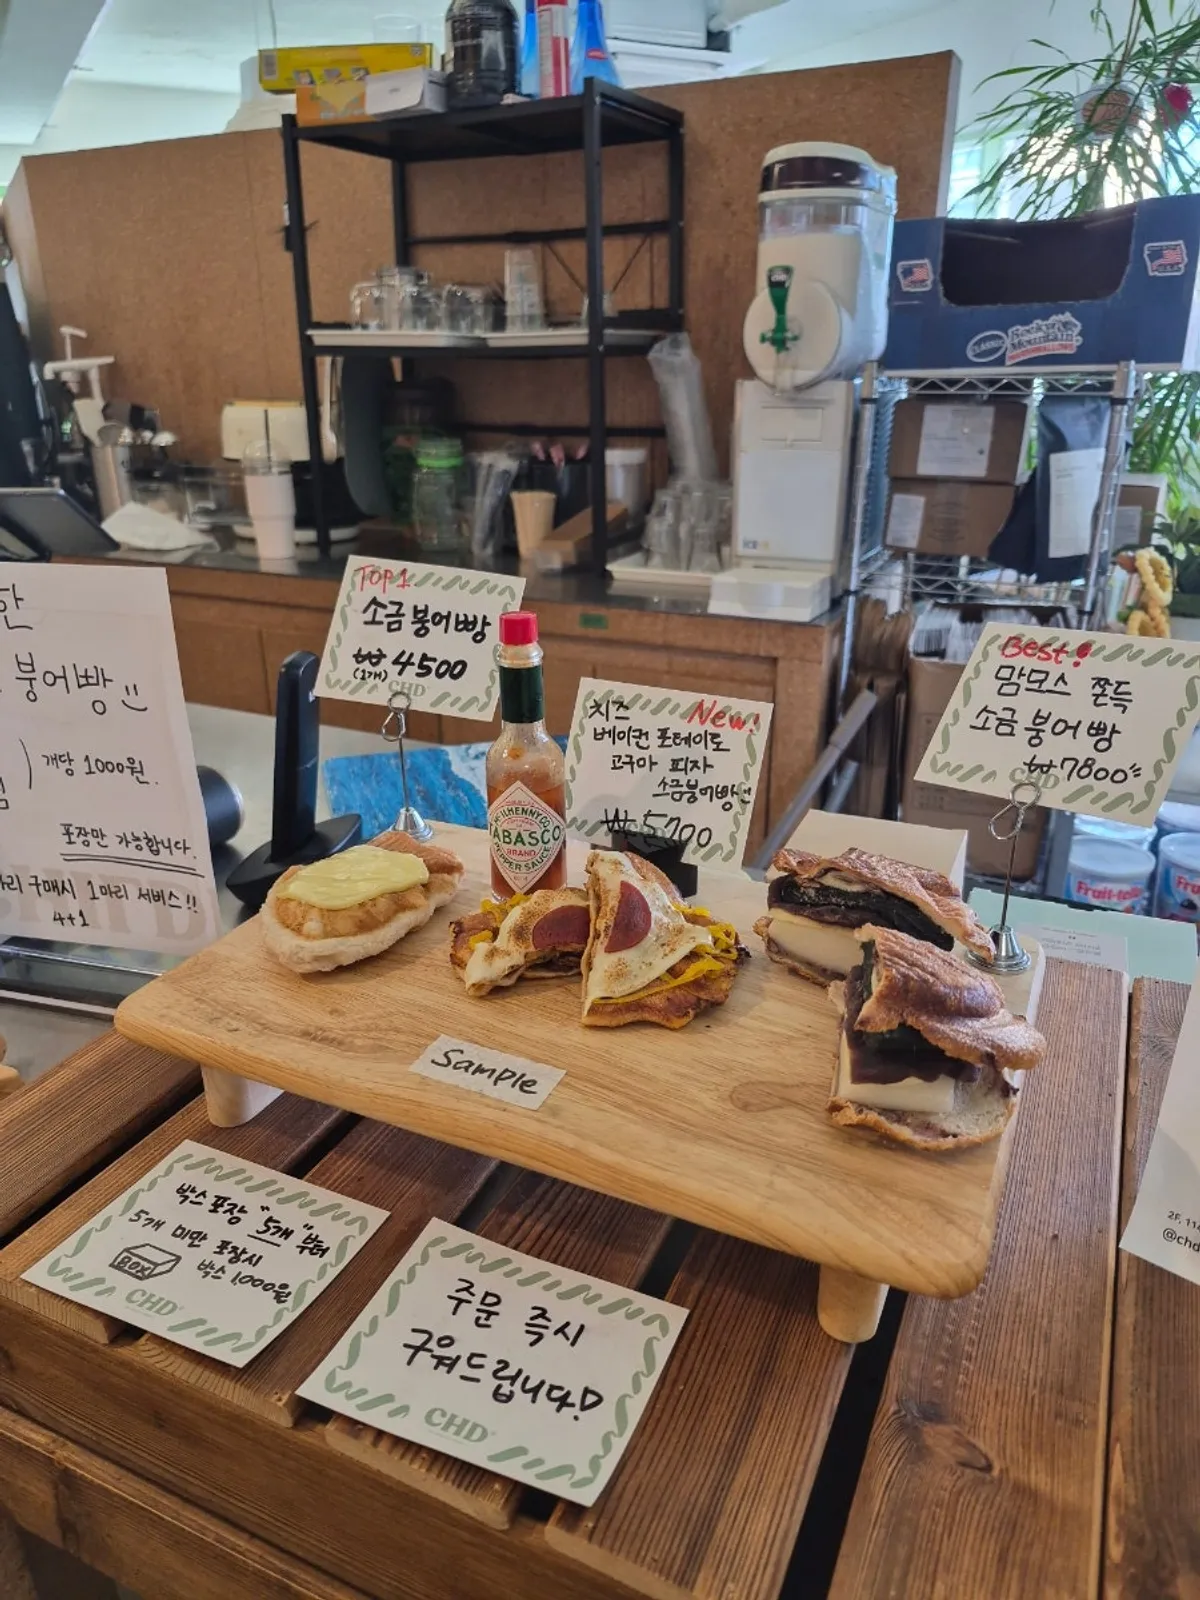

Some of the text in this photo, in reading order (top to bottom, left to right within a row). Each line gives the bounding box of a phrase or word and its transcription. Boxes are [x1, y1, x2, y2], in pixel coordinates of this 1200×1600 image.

[362, 597, 406, 633] 소금
[15, 651, 114, 716] 붕어빵
[994, 665, 1133, 714] 맘모스 쫀득
[588, 699, 630, 722] 치즈
[686, 699, 760, 735] New!
[969, 705, 1018, 736] 소금
[41, 752, 74, 776] 개당
[611, 755, 714, 775] 고구마 피자
[60, 823, 109, 848] 포장만
[28, 875, 76, 900] 구매시
[87, 879, 129, 900] 1마리
[53, 909, 90, 927] 4+1
[431, 1048, 538, 1095] Sample
[175, 1182, 207, 1206] 박스
[208, 1194, 248, 1226] 포장
[295, 1232, 331, 1259] 부터
[128, 1208, 263, 1268] 5개 미만 포장시
[117, 1255, 152, 1277] BOX
[196, 1258, 226, 1280] 박스
[125, 1288, 179, 1316] CHD
[447, 1278, 585, 1348] 주문 즉시
[424, 1407, 489, 1443] CHD
